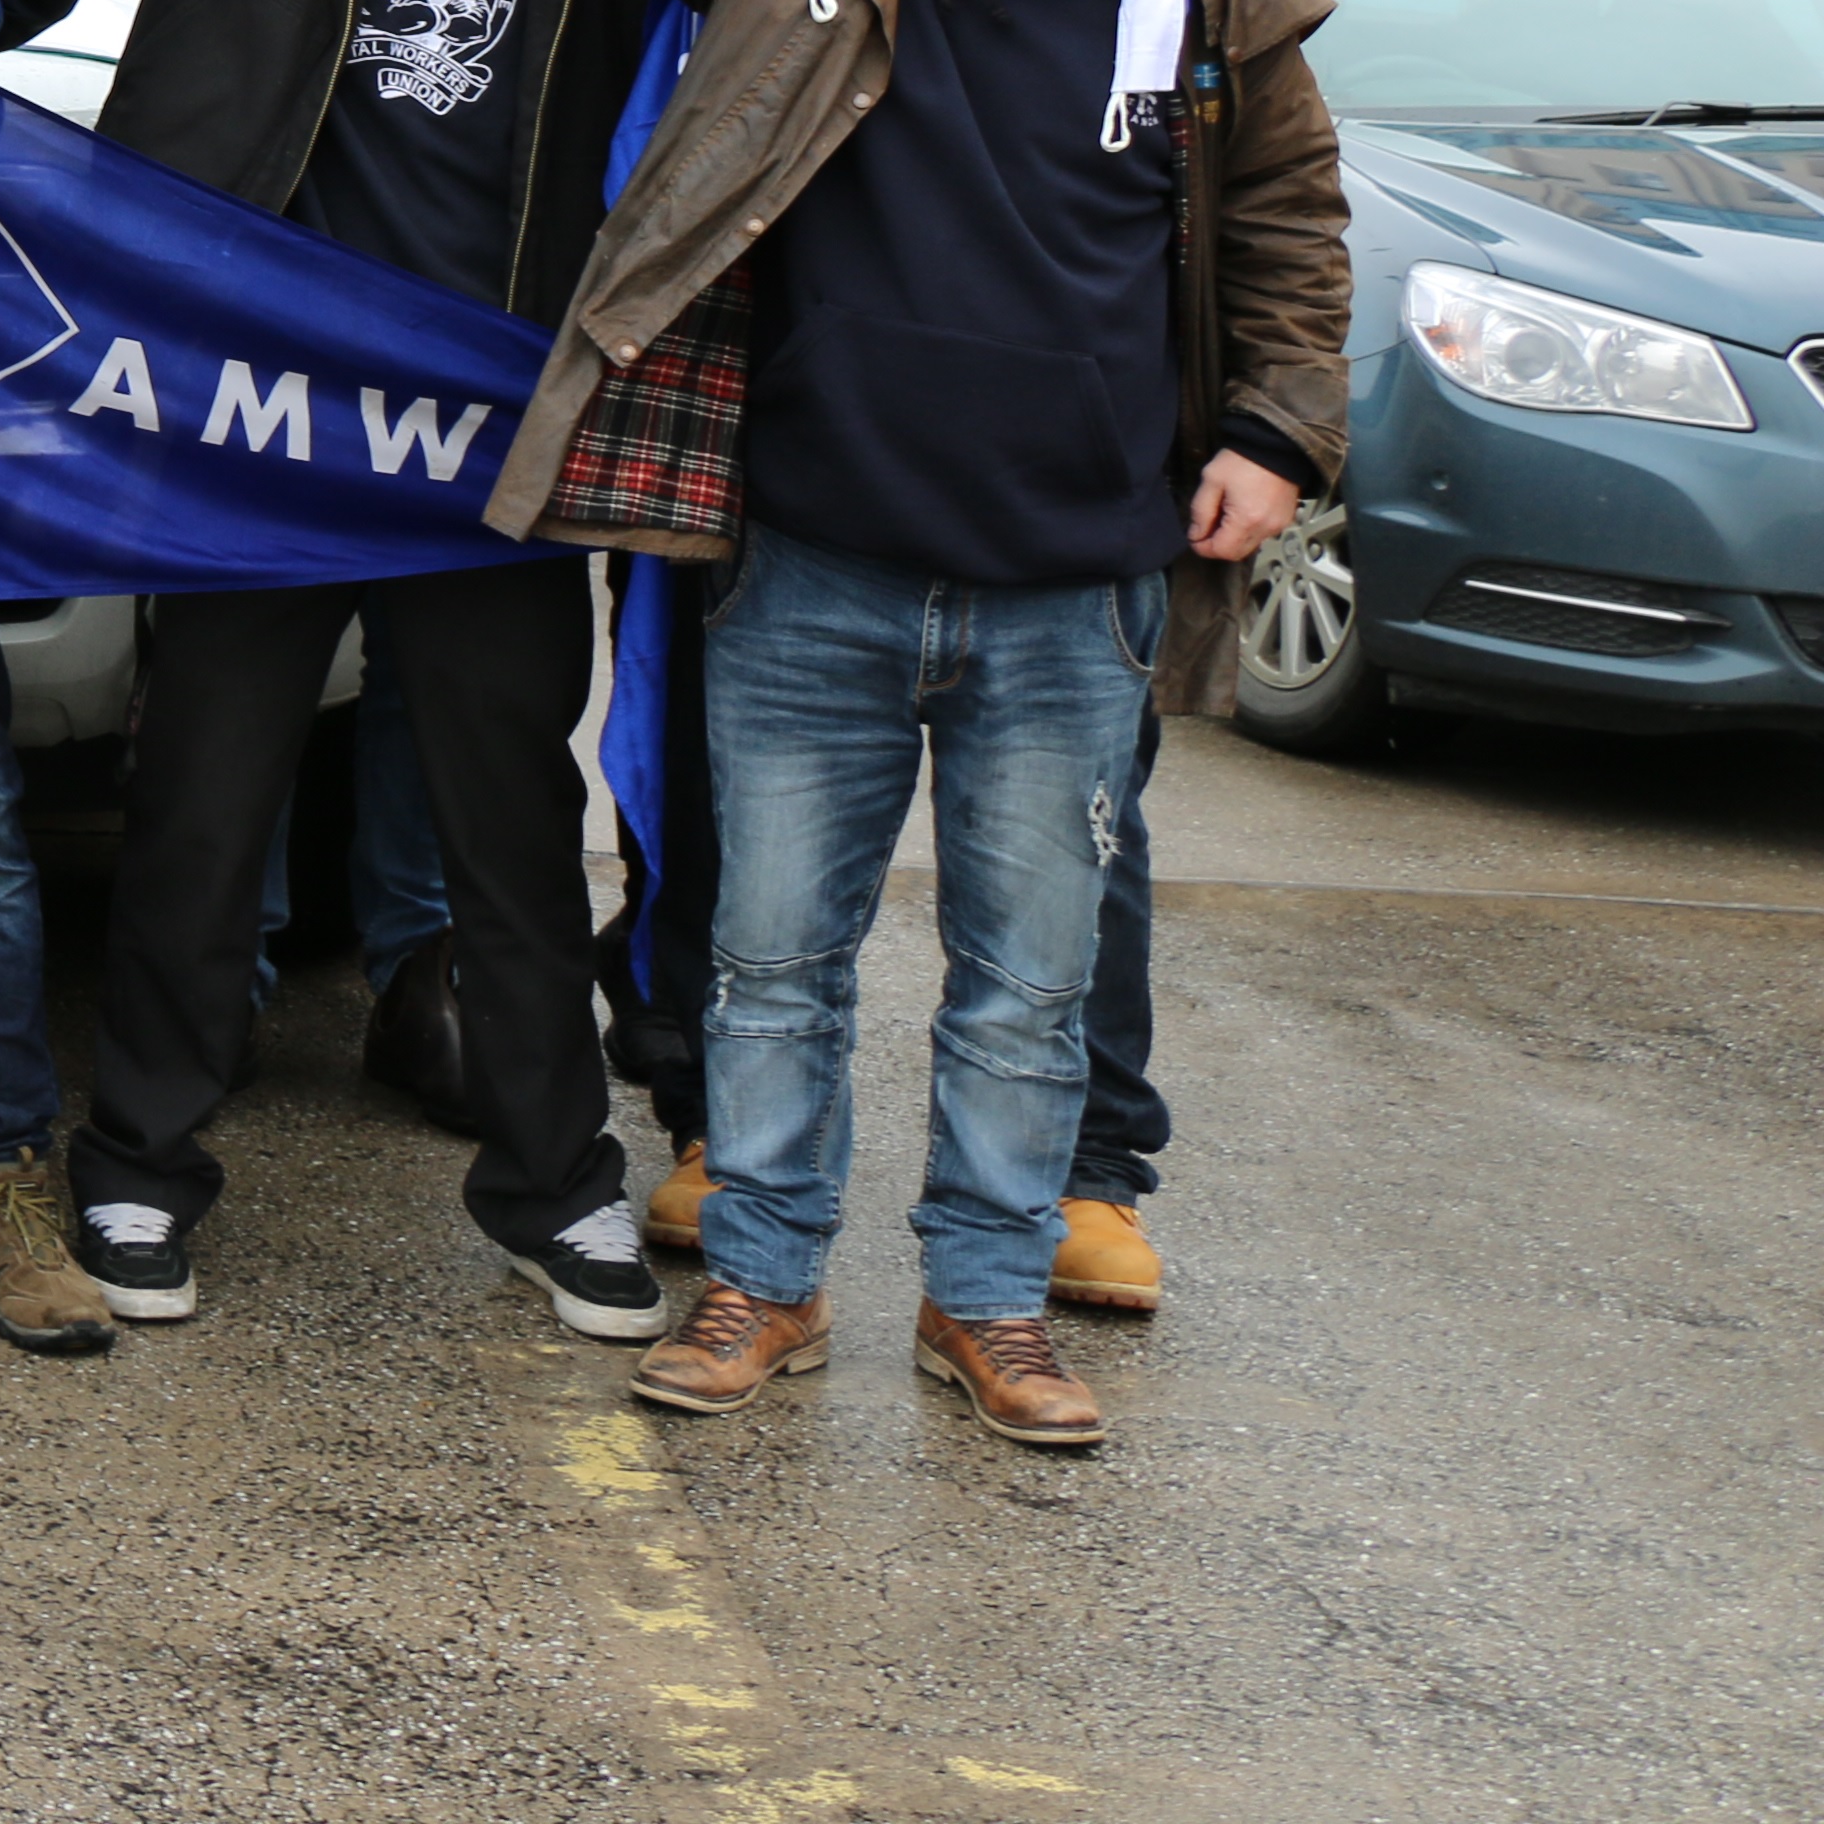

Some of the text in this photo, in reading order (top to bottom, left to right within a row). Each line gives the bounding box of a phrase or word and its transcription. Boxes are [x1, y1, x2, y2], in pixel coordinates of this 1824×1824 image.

[387, 72, 446, 108] UNION
[389, 41, 470, 94] WORKERS
[68, 336, 493, 482] AMW
